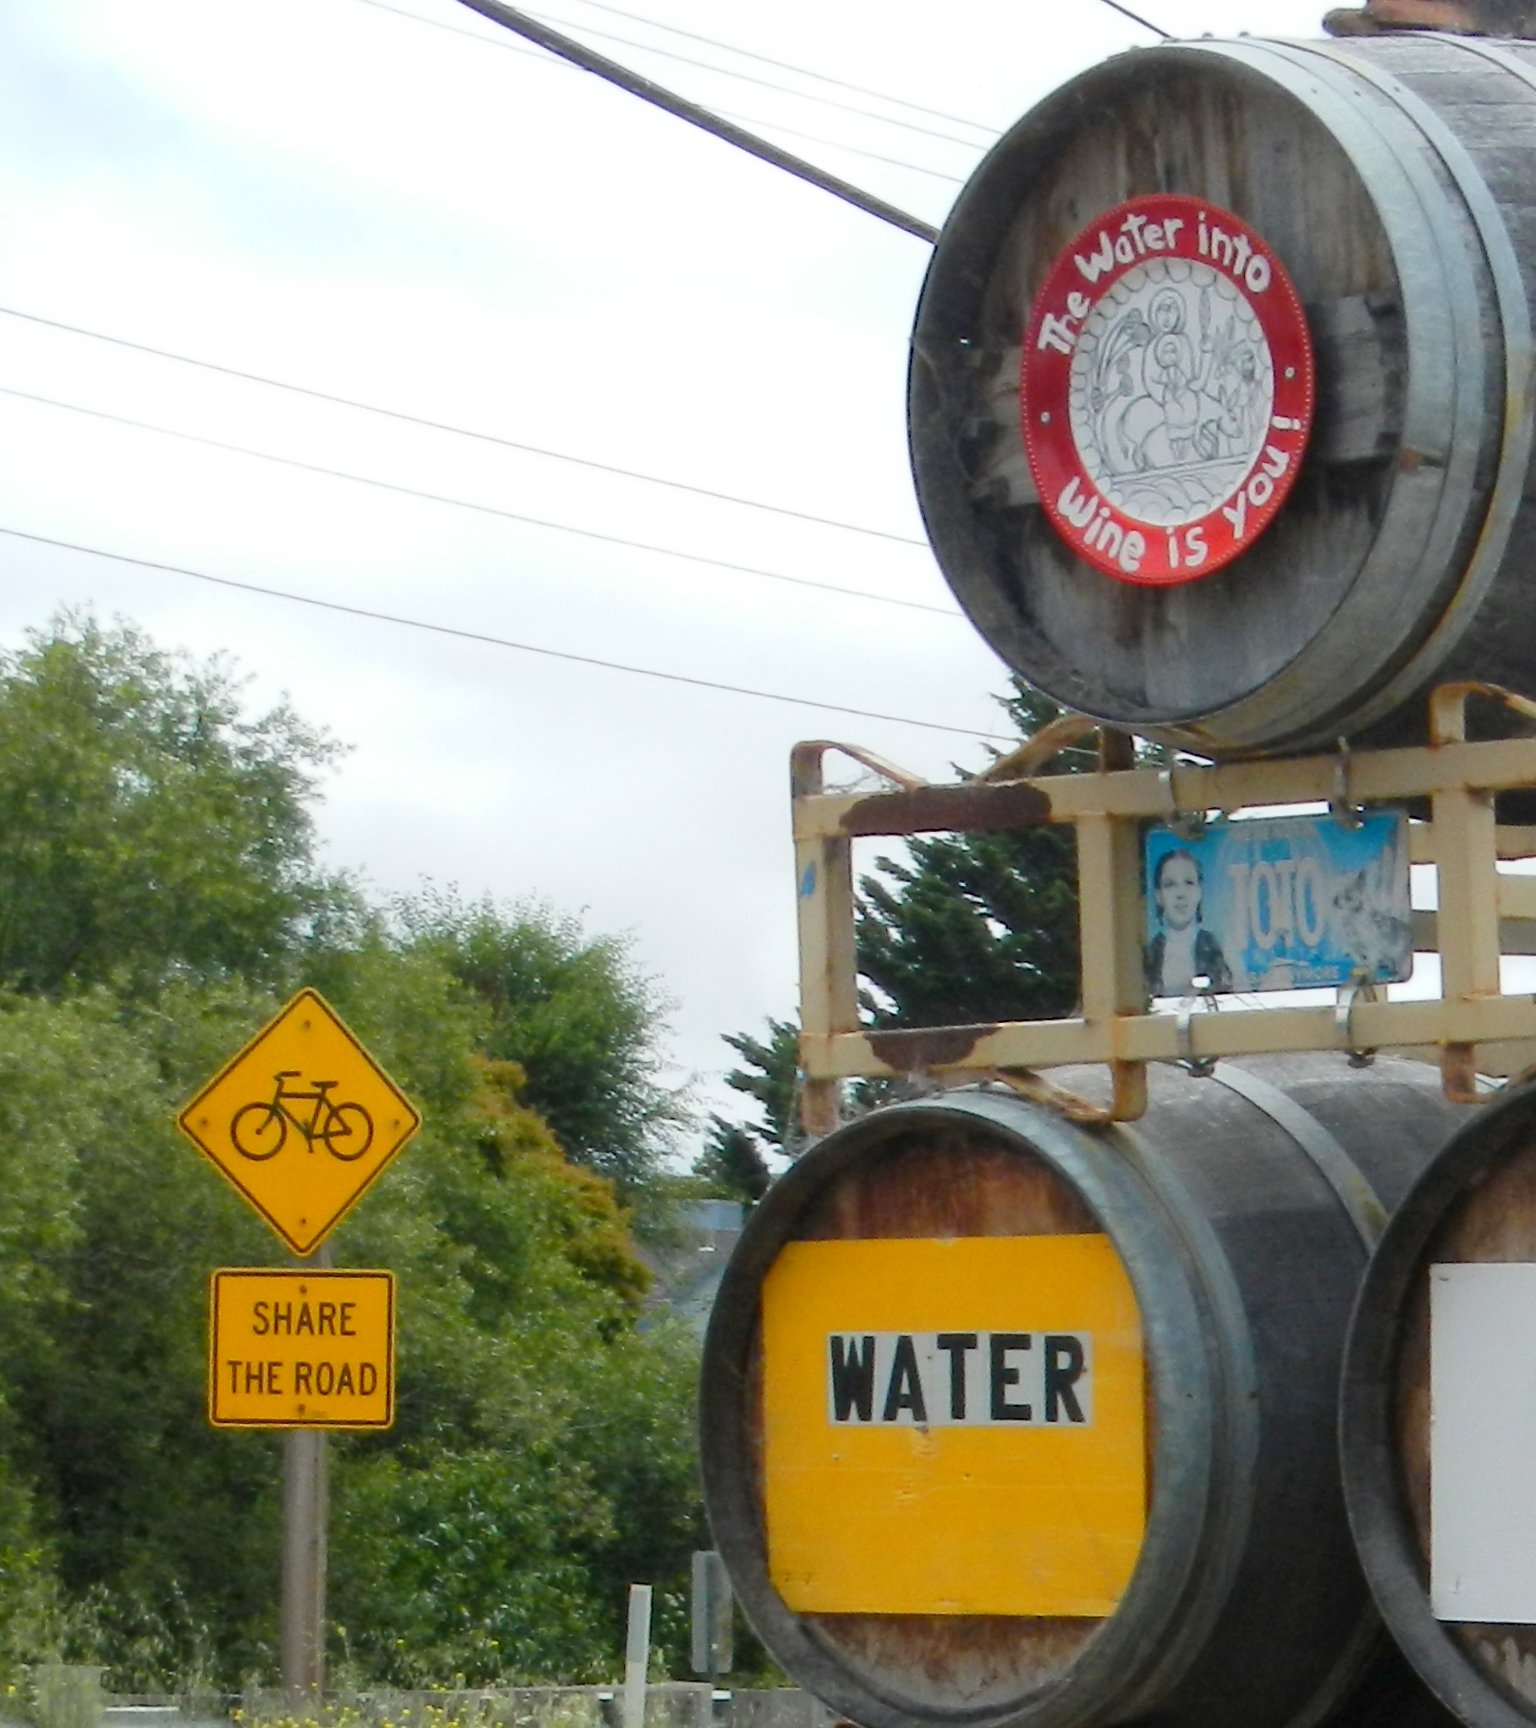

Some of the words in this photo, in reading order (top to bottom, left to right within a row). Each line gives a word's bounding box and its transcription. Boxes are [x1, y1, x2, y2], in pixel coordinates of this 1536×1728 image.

[1037, 290, 1091, 355] The
[1074, 212, 1184, 284] Water
[1197, 211, 1272, 294] into
[1165, 526, 1209, 569] is
[1226, 857, 1325, 949] TOTO
[252, 1300, 357, 1337] SHARE
[227, 1360, 283, 1396] THE
[295, 1361, 378, 1397] ROAD
[829, 1332, 1086, 1423] WATER
